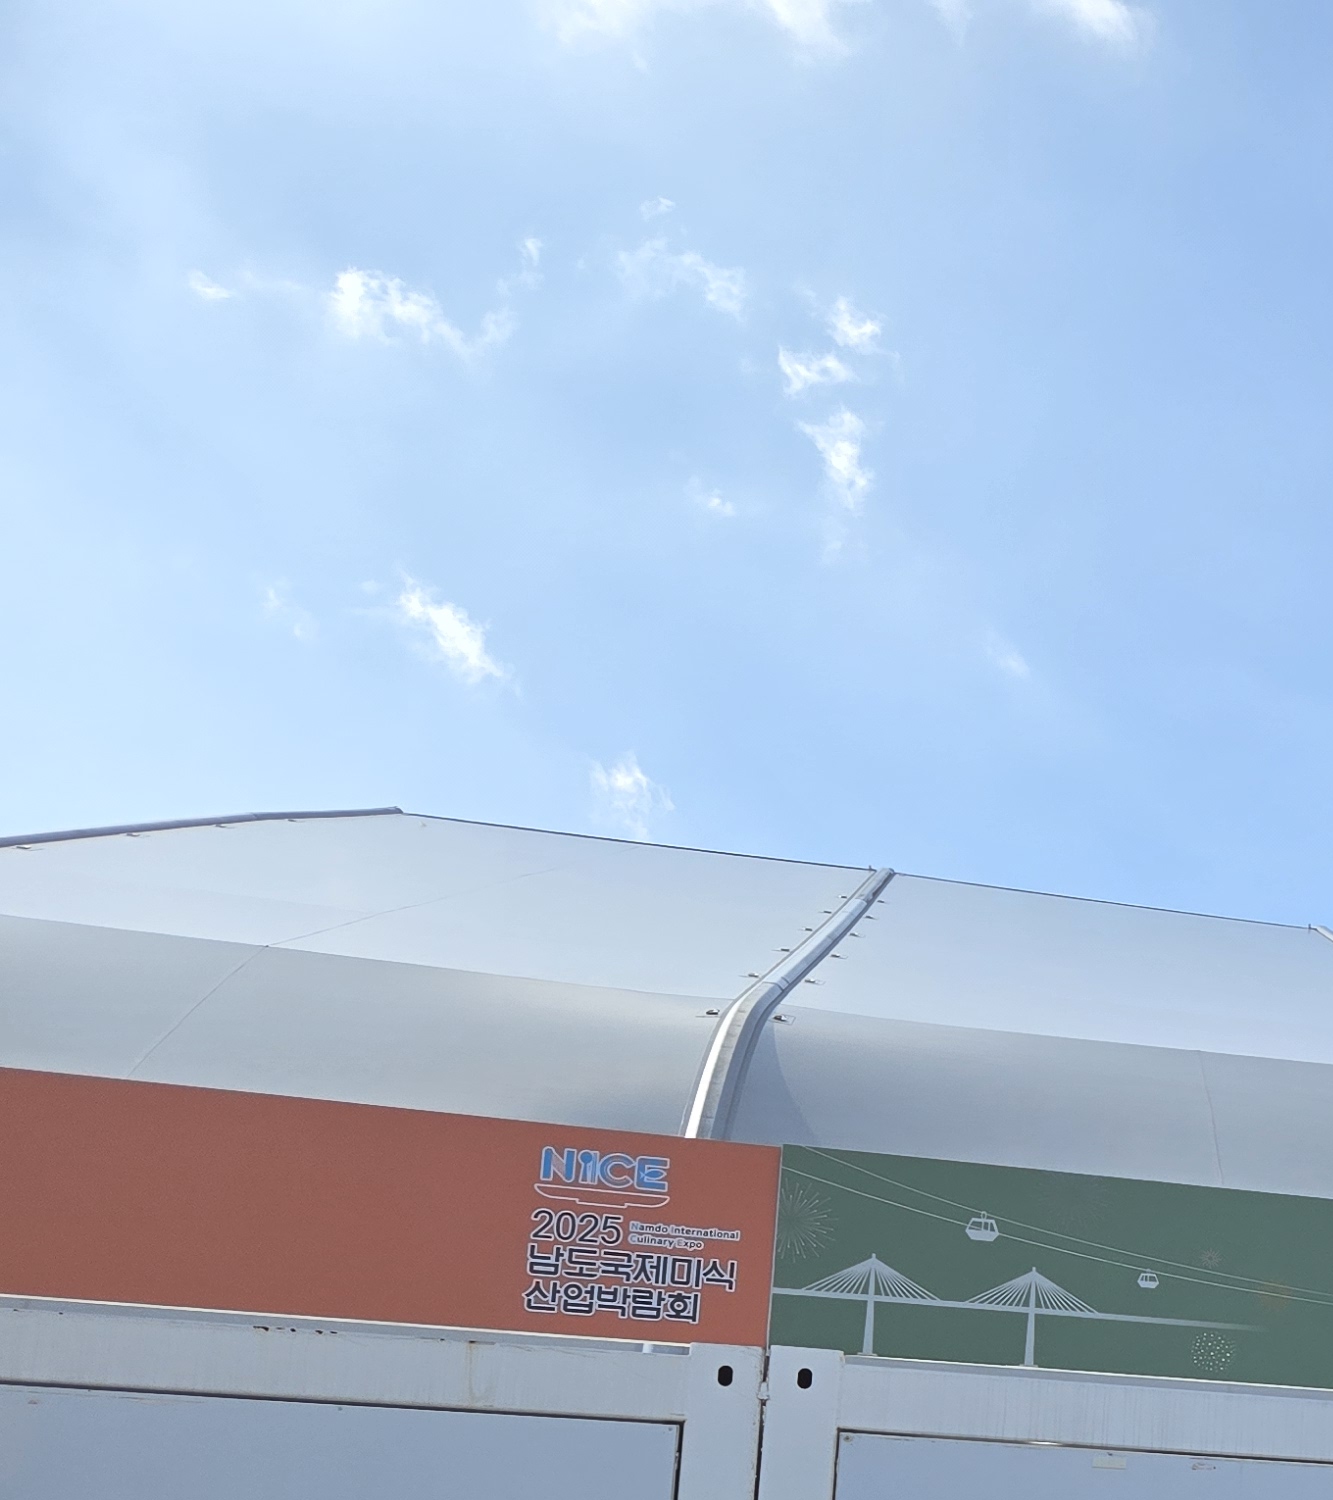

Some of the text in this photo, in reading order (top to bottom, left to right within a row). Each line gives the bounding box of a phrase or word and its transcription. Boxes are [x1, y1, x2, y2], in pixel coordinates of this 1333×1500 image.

[530, 1208, 624, 1246] 2025
[628, 1234, 704, 1251] Culinary Expo
[629, 1221, 740, 1241] Namdo International
[526, 1244, 737, 1292] 남도국제미식
[522, 1278, 700, 1324] 산업박람회
